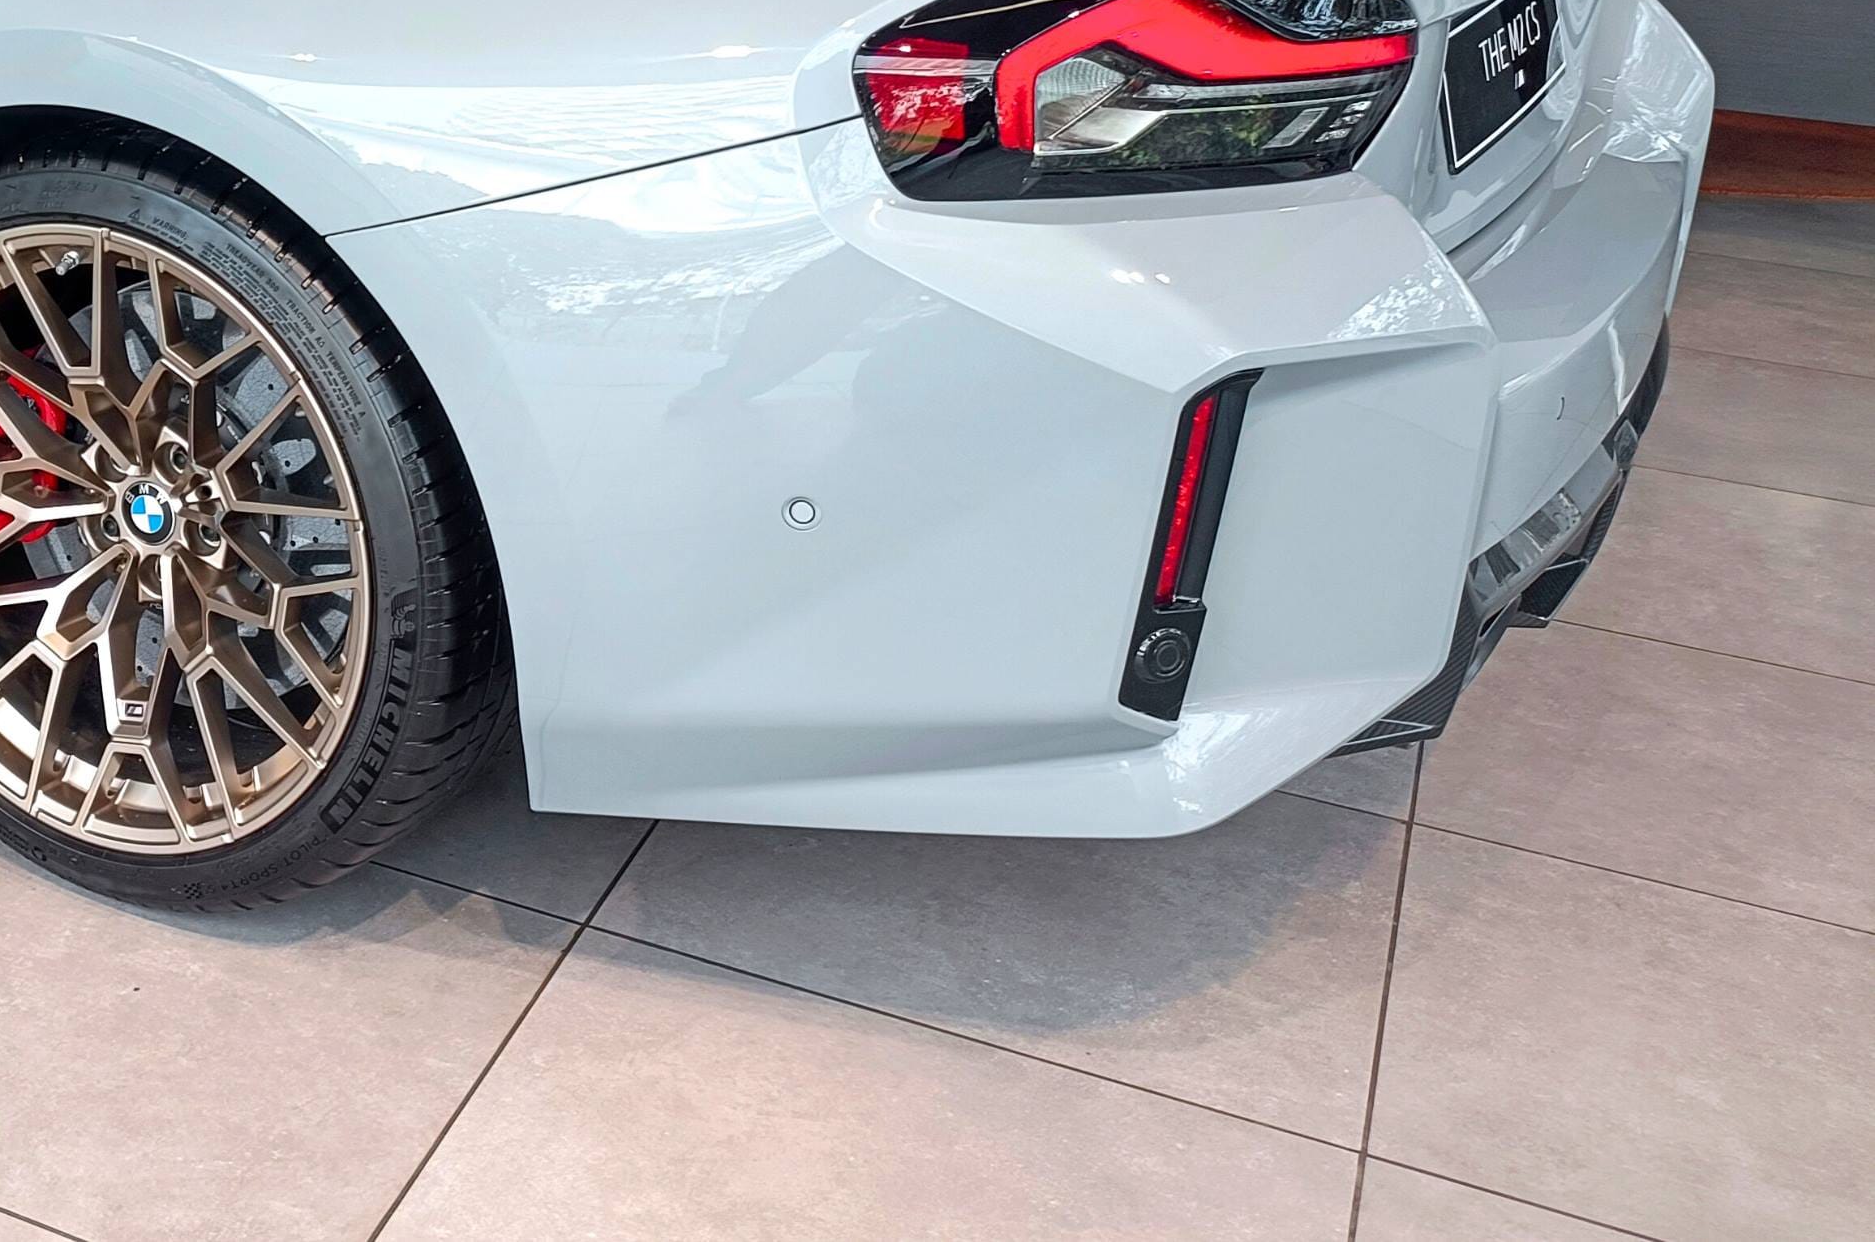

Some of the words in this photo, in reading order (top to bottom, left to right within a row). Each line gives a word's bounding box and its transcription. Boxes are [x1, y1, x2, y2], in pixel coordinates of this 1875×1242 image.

[1477, 27, 1510, 82] THE
[1507, 13, 1528, 61] M2
[1524, 0, 1541, 46] CS
[285, 298, 317, 335] TRACTION
[326, 350, 362, 408] TEMPERATURE
[124, 483, 168, 505] BMW
[327, 646, 413, 826] MICHELIN
[230, 864, 279, 890] SPORT
[283, 836, 323, 867] PILOT
